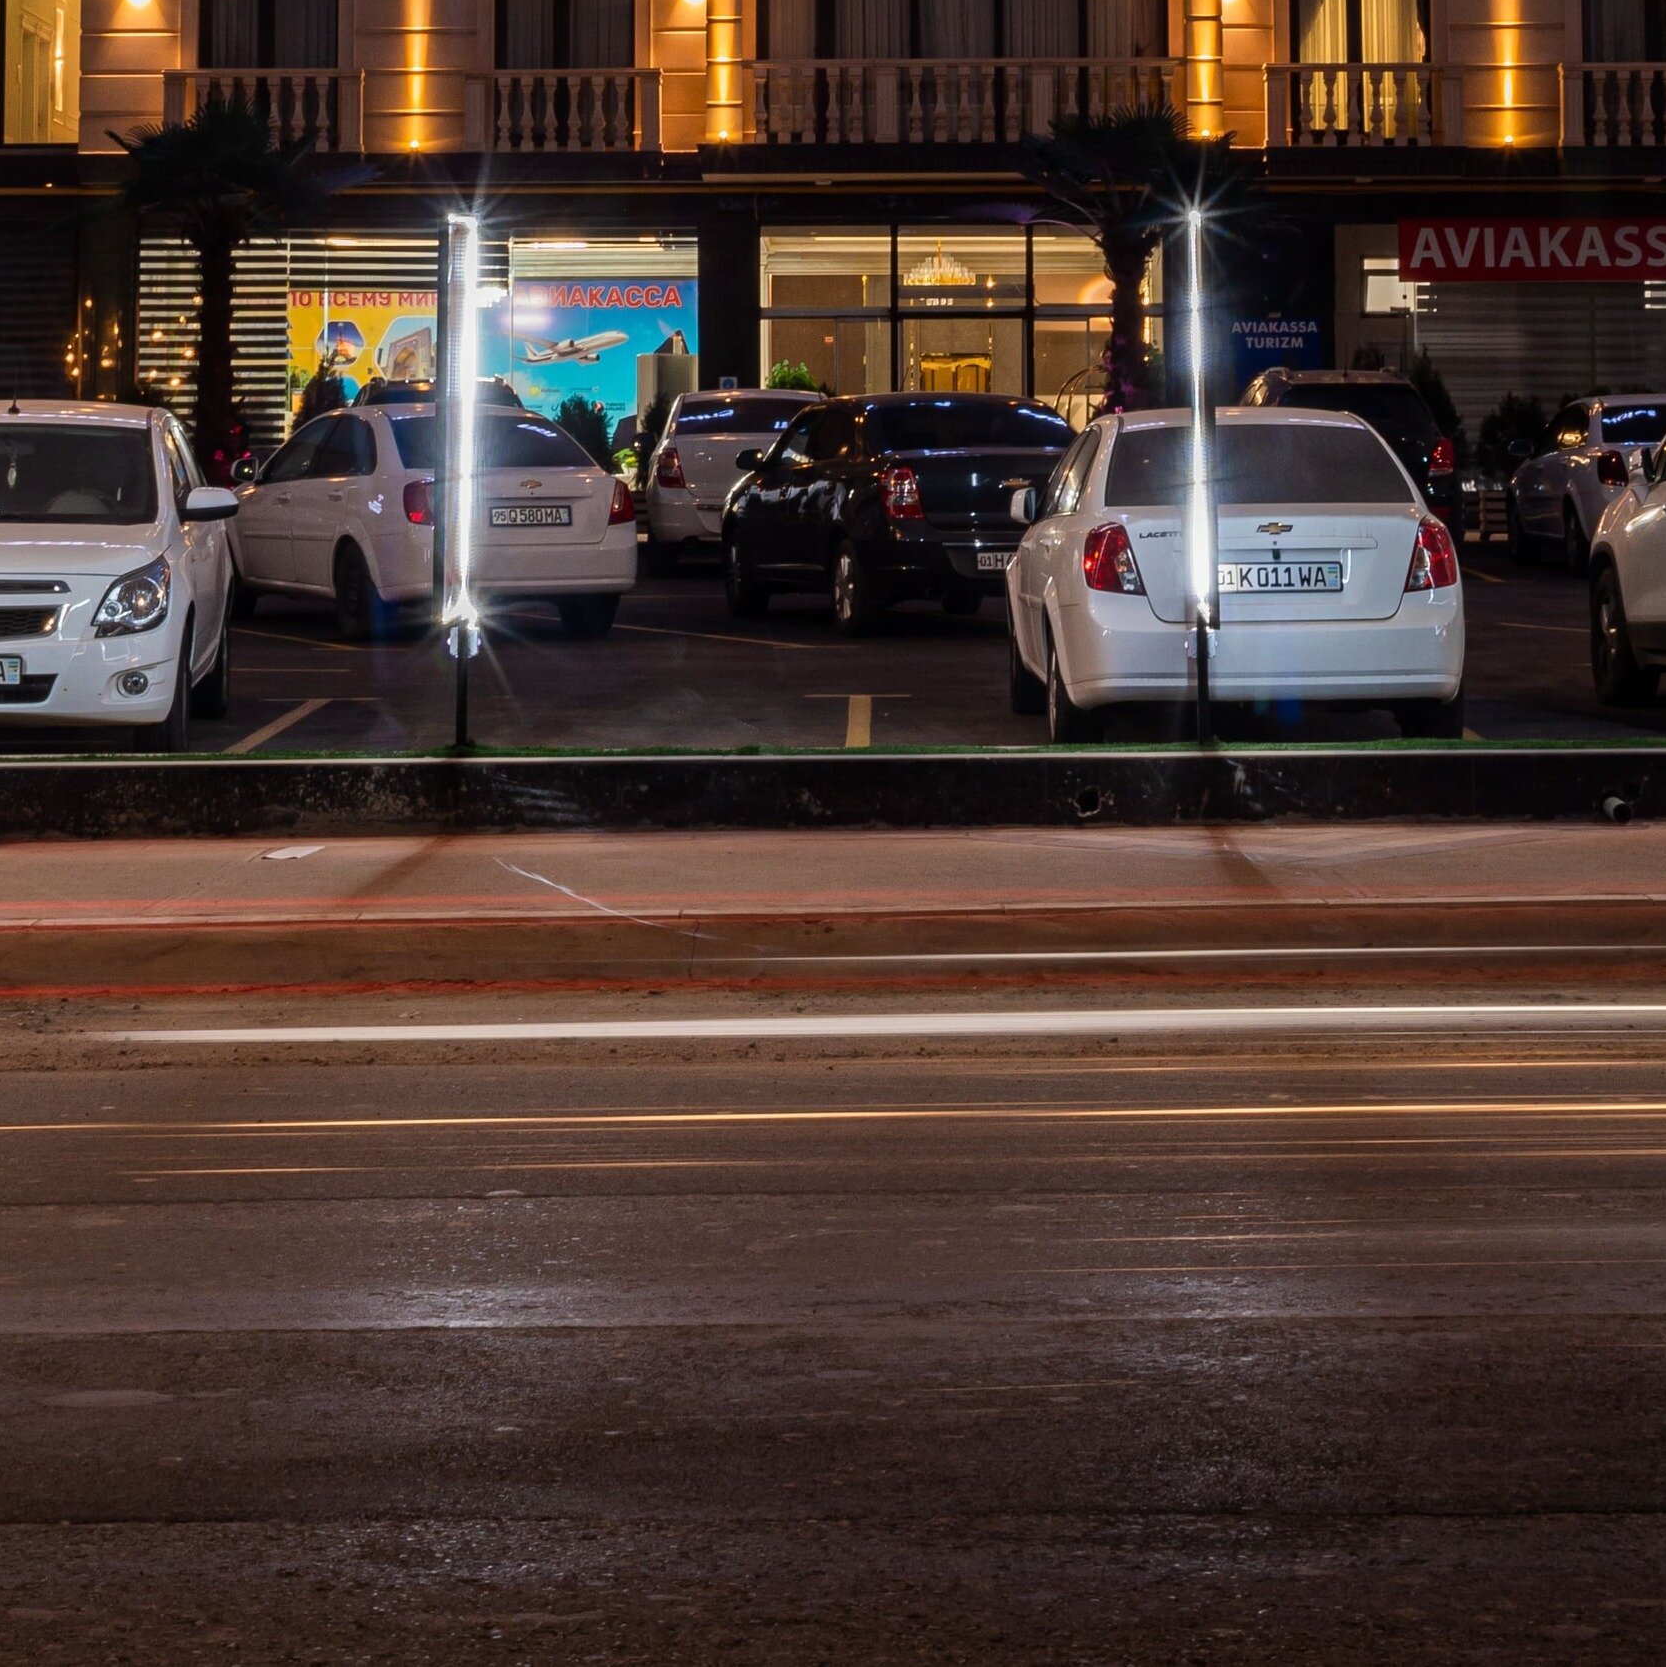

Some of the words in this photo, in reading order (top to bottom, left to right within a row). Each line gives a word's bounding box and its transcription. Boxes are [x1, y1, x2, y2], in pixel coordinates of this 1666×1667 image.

[513, 286, 683, 308] АВИАКАССА
[1232, 322, 1318, 333] AVIAKASSA
[1245, 337, 1304, 349] TURIZM
